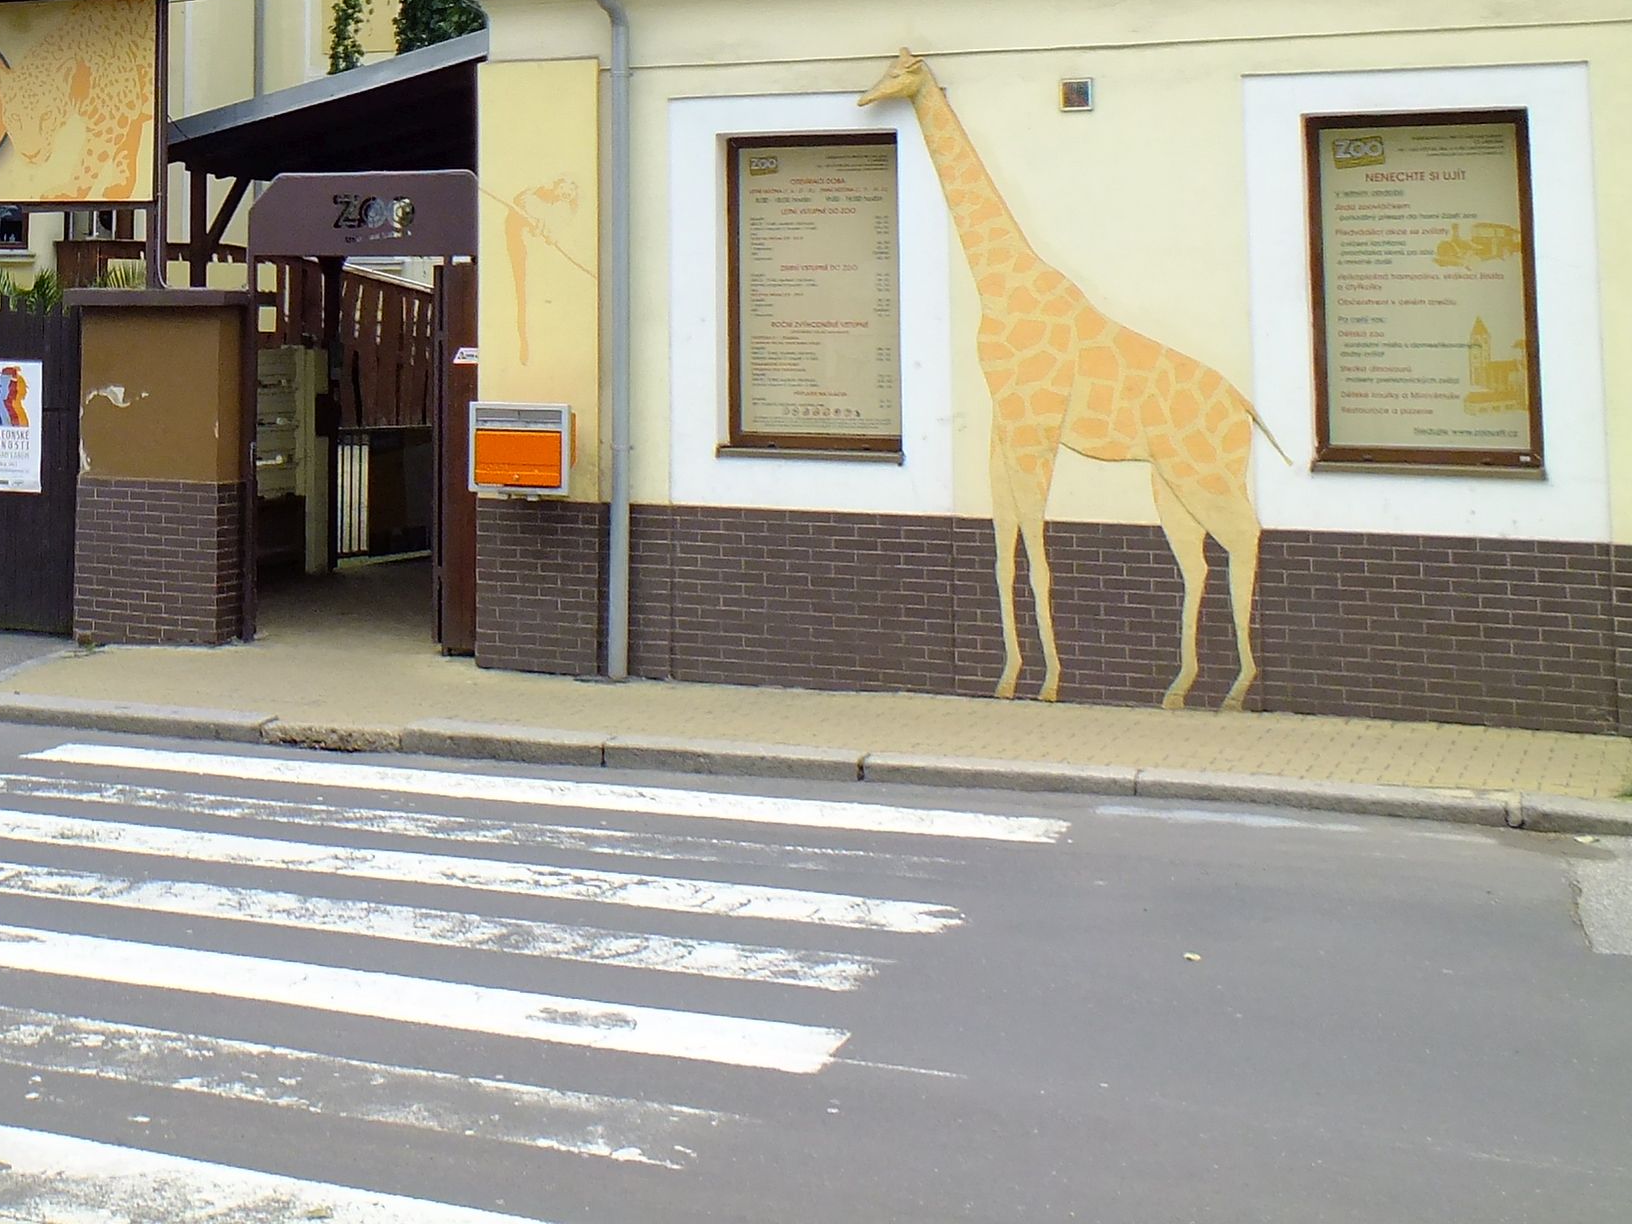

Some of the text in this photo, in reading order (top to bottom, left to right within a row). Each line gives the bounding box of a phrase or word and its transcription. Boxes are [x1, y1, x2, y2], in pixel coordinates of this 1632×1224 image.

[1335, 138, 1384, 158] ZOO
[1365, 169, 1467, 182] NENECHTE SI UJÍT
[333, 194, 415, 228] ZOO
